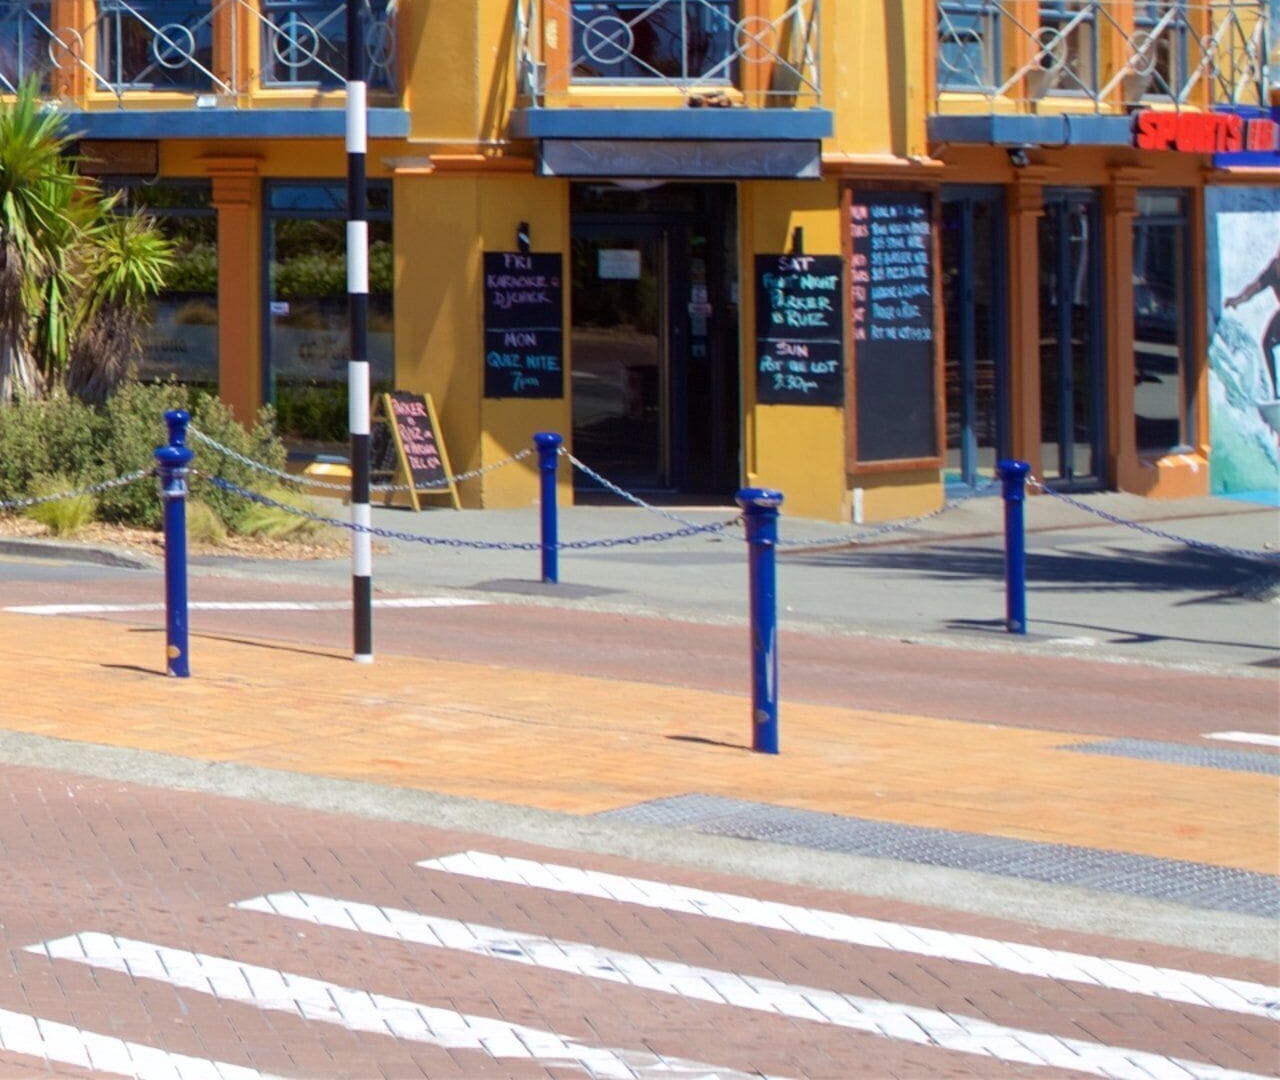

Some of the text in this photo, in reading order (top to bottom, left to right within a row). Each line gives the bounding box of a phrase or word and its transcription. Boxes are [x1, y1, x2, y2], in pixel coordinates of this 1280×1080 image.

[1137, 109, 1244, 152] SPORTS
[503, 253, 533, 270] FRI
[778, 256, 816, 272] SAT
[504, 332, 537, 348] MON
[775, 340, 809, 358] SUN
[525, 354, 561, 371] NITE
